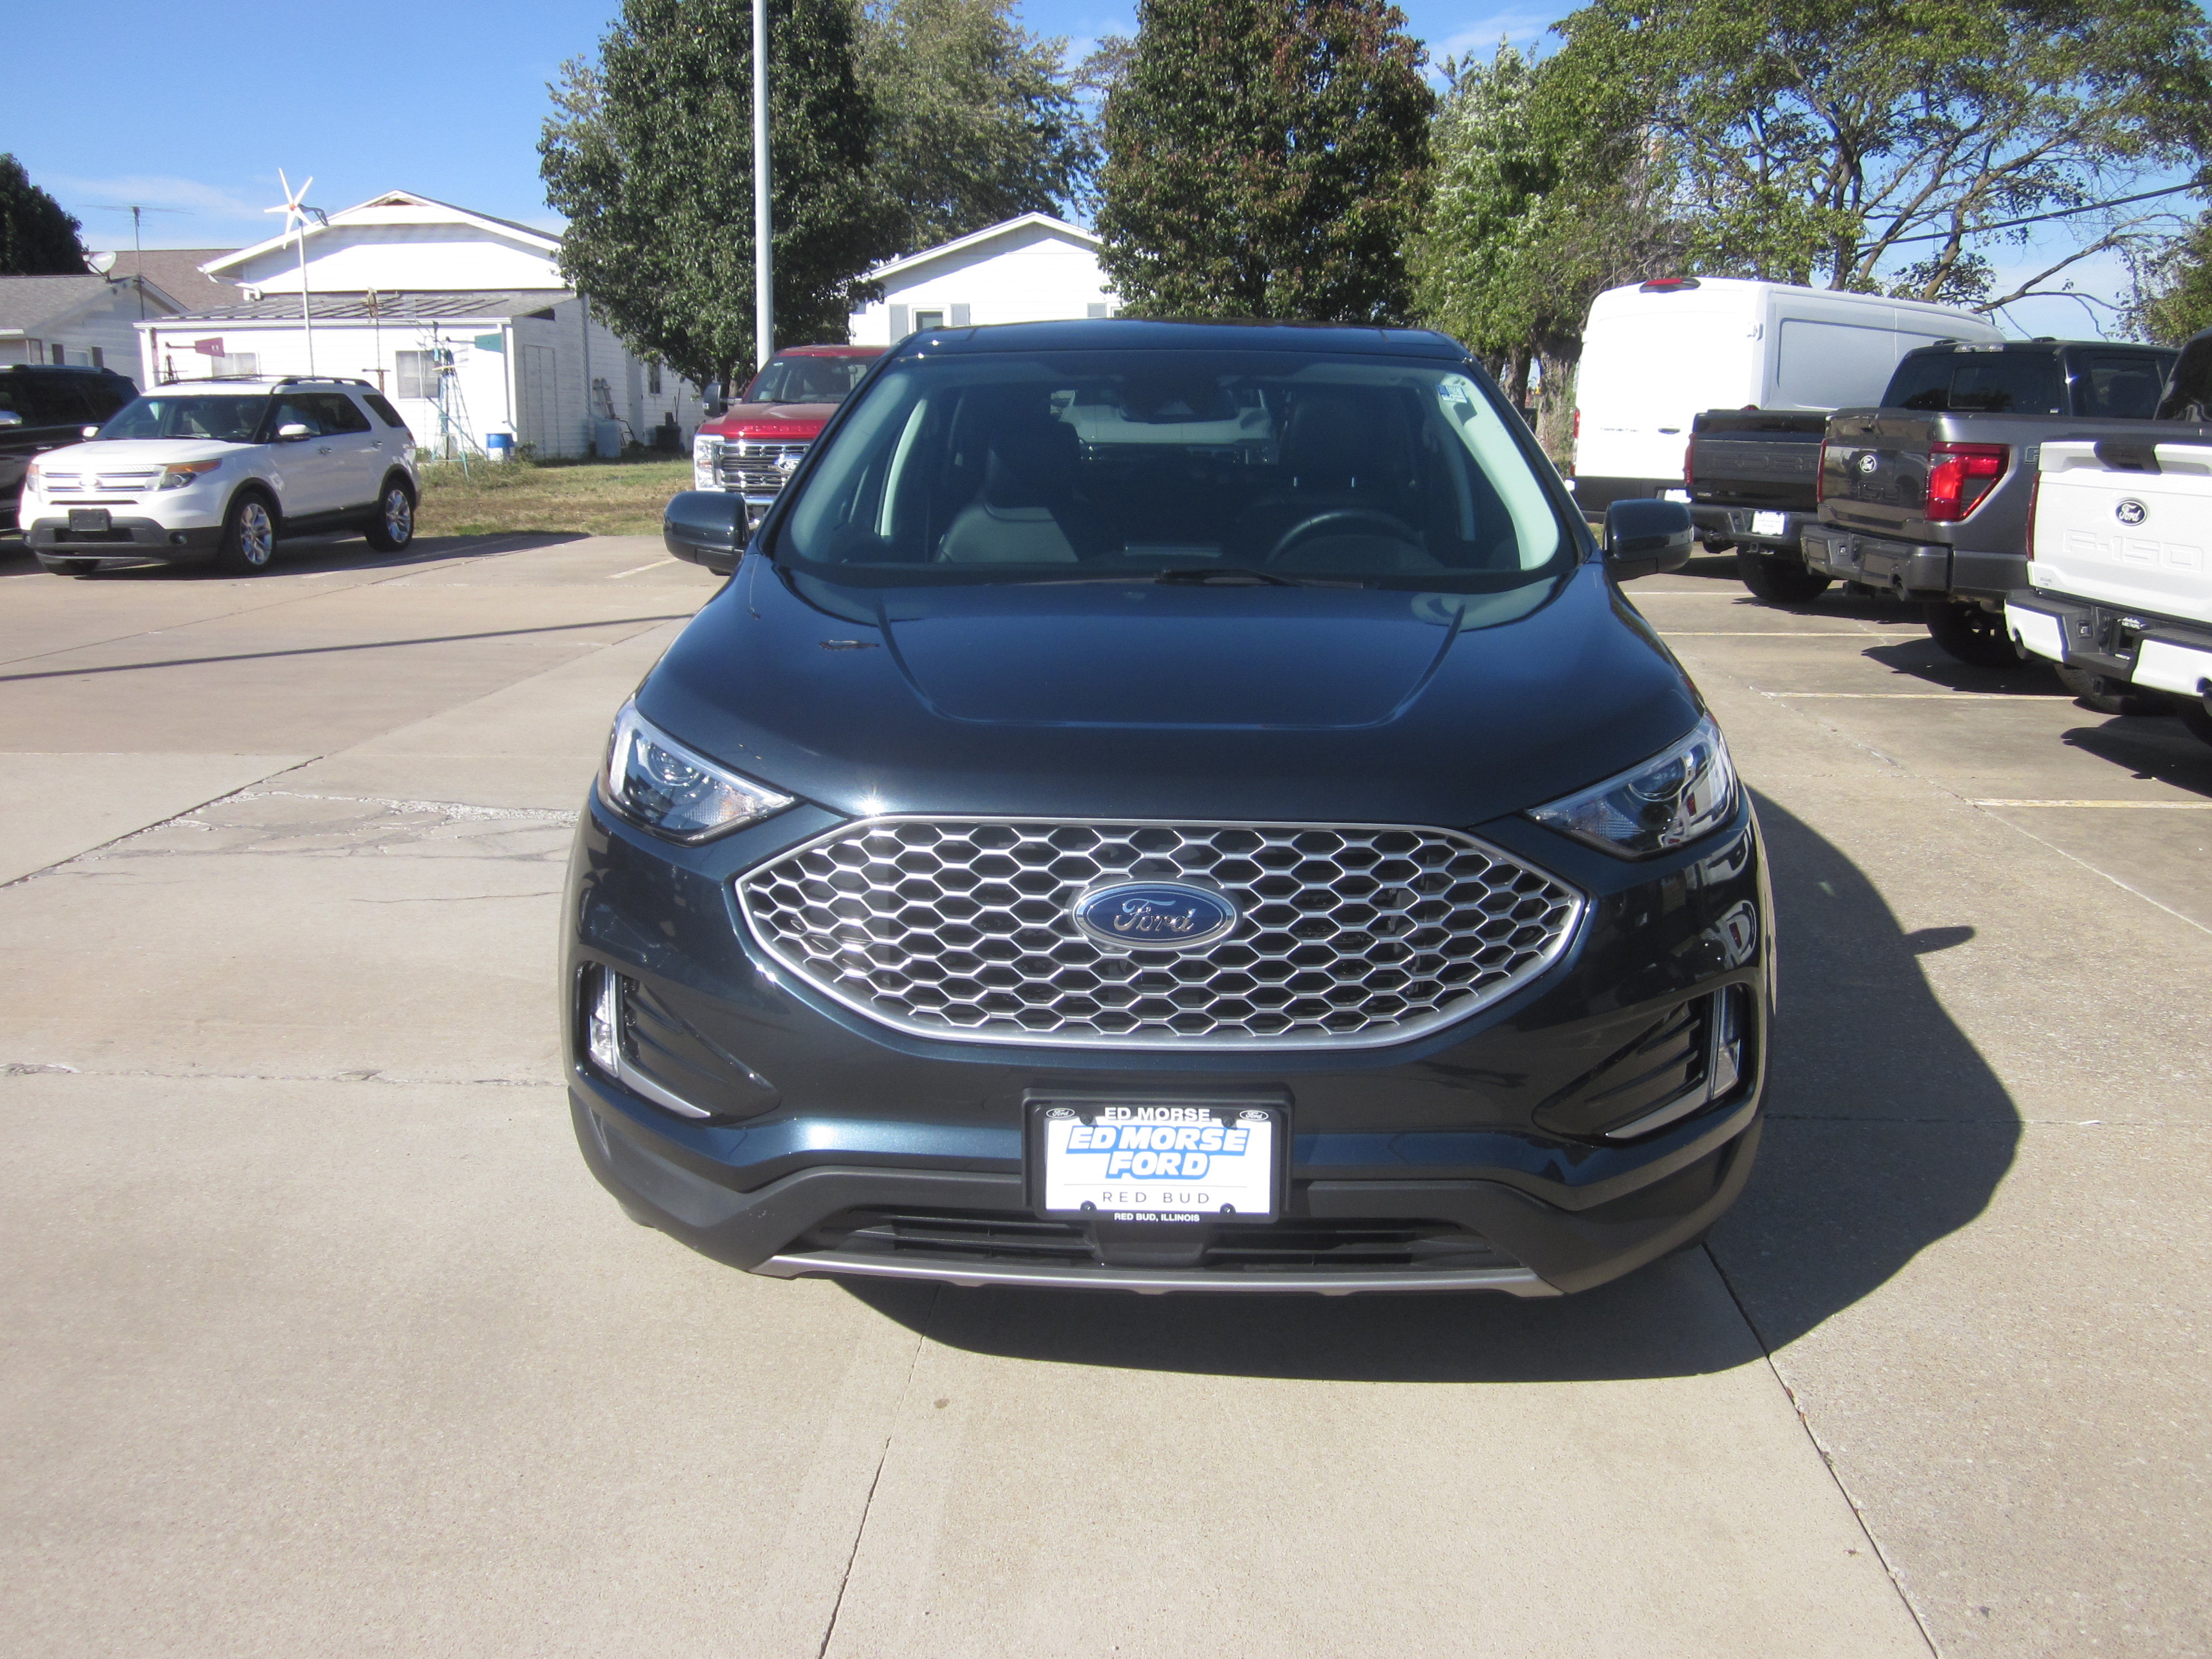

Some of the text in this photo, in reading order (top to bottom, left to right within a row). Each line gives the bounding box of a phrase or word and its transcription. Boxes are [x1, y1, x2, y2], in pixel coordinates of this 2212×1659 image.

[784, 460, 797, 469] Fo
[2118, 503, 2141, 522] Ford
[2063, 529, 2203, 573] F-150
[1113, 898, 1197, 932] Ford
[1105, 1107, 1211, 1121] ED MORSE
[1067, 1126, 1249, 1152] ED MORSE
[1108, 1151, 1208, 1176] FORD
[1103, 1191, 1209, 1204] RED BUD
[1114, 1212, 1200, 1222] RED BUD, ILLINOIS
